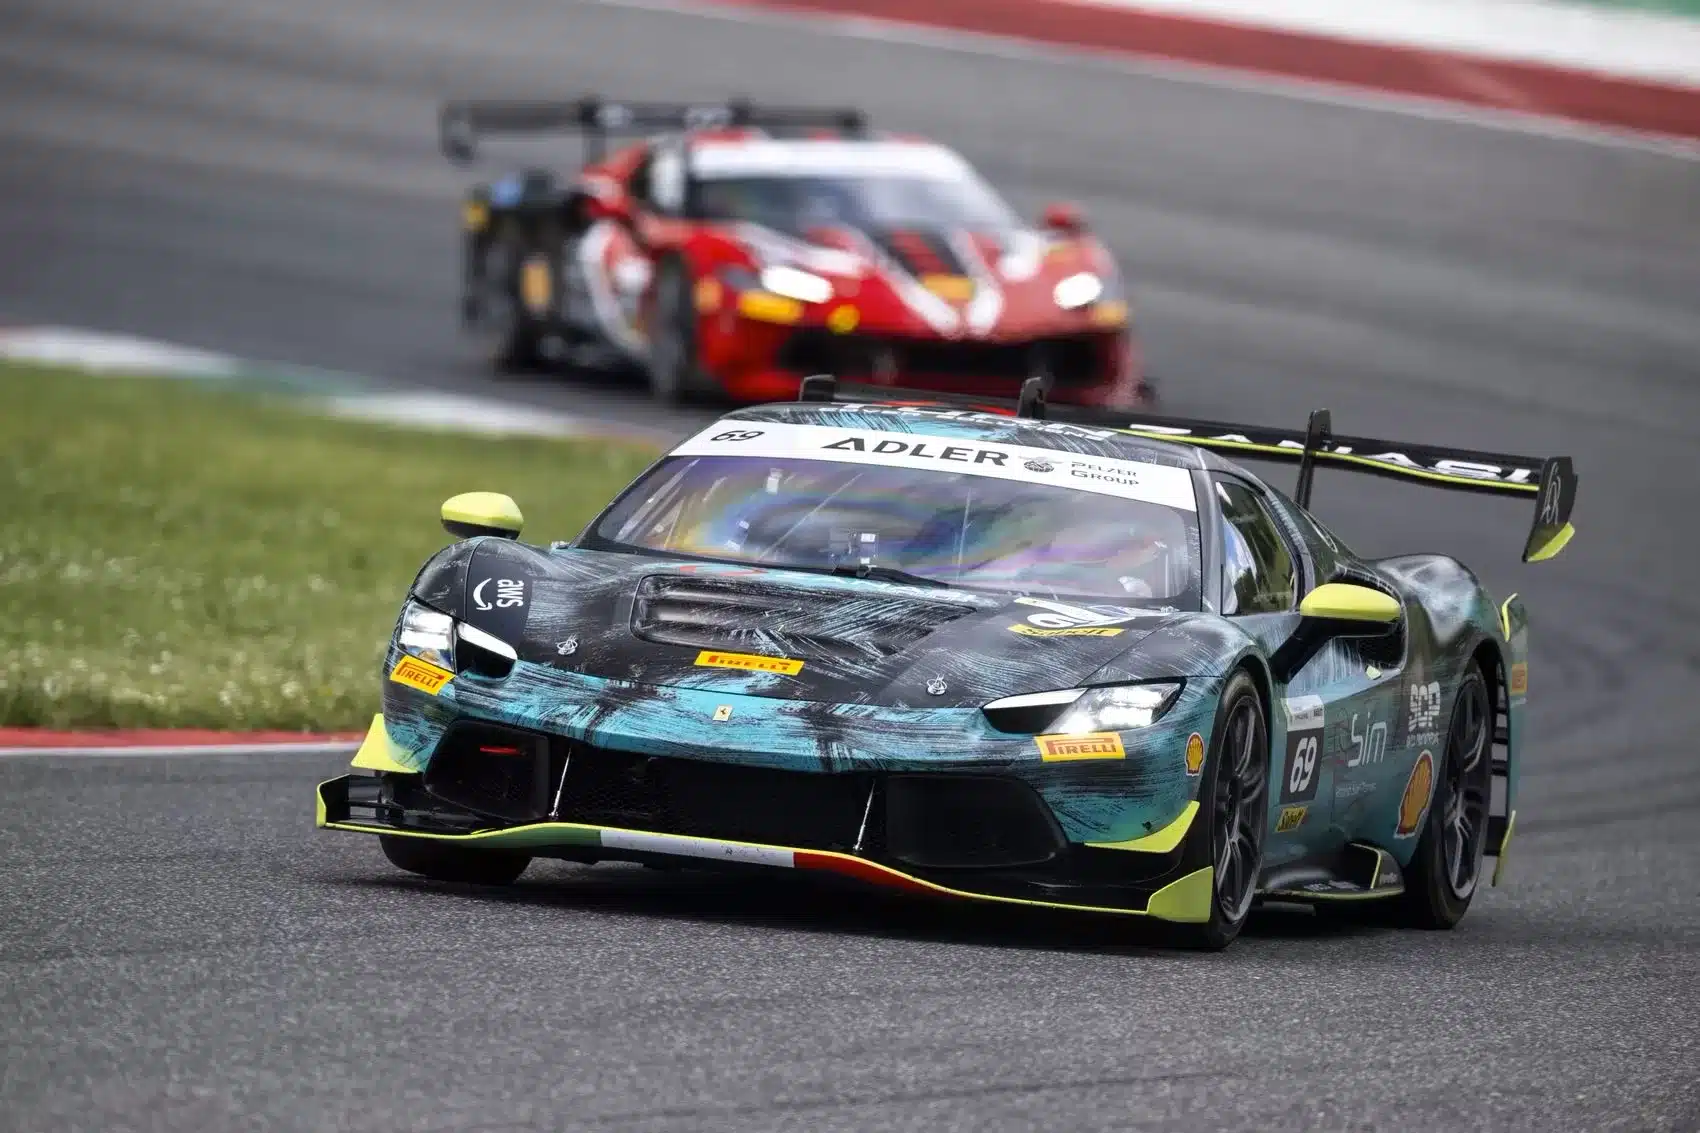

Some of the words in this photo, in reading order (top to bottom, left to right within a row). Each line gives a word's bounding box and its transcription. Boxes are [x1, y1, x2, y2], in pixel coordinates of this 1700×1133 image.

[710, 430, 765, 442] 69
[820, 437, 1010, 467] ADLER
[1071, 461, 1137, 477] PELZER
[1071, 469, 1139, 486] GROUP
[496, 578, 524, 608] aws
[396, 662, 445, 688] PIRELLI
[1045, 738, 1117, 756] PIRELLI
[1289, 736, 1318, 793] 69
